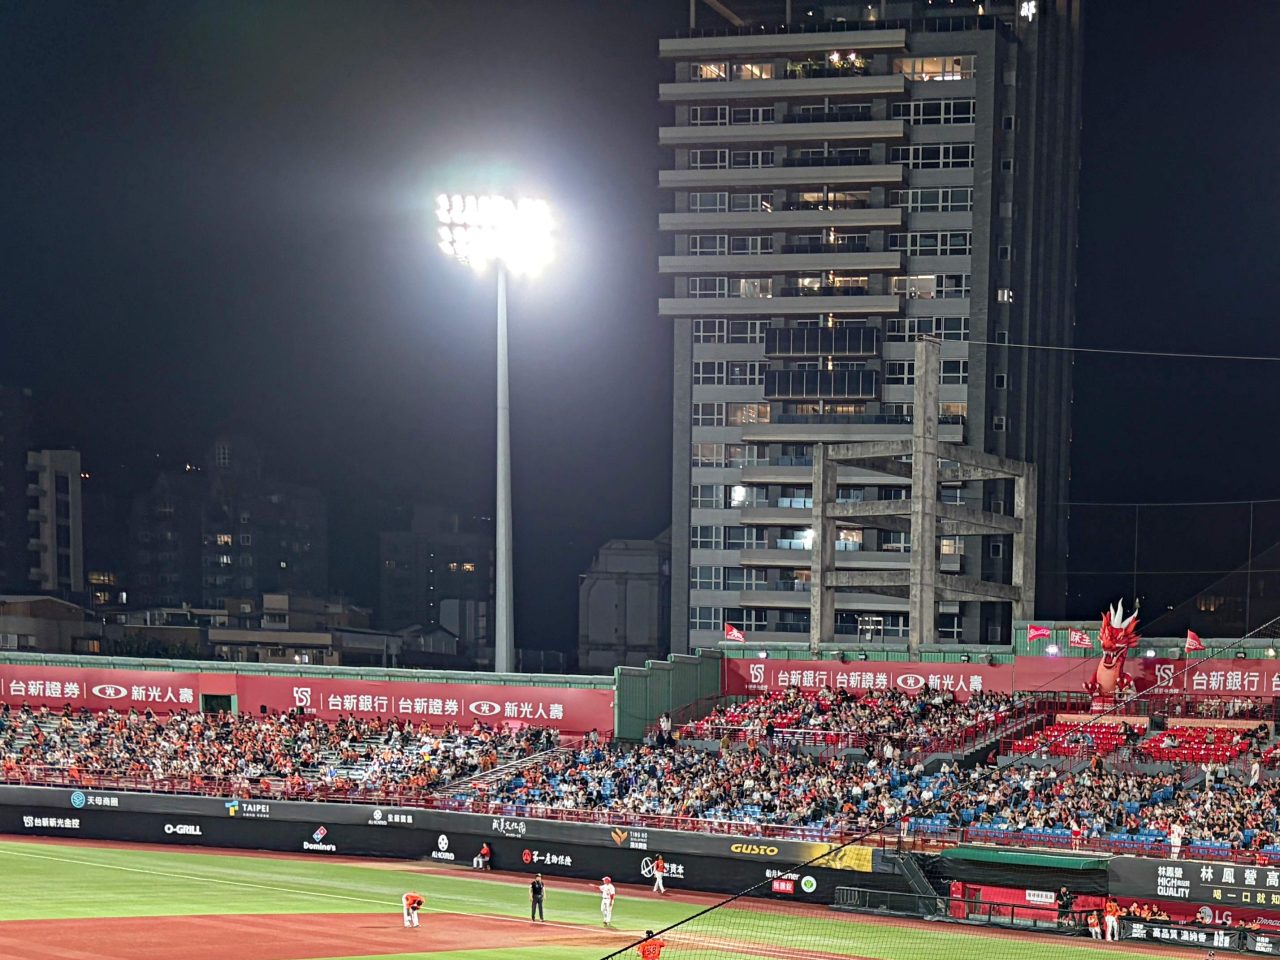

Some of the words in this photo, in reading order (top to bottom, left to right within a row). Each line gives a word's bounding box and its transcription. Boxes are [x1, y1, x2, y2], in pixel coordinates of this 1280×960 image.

[778, 670, 827, 688] 台新銀行
[836, 671, 888, 689] 台新證券
[928, 674, 983, 692] 新光人壽
[1192, 672, 1259, 692] 台新銀行
[9, 680, 81, 699] 台新證券
[131, 685, 194, 703] 新光人壽
[327, 694, 388, 712] 台新銀行
[398, 697, 459, 716] 台新證券
[504, 702, 564, 719] 新光人壽
[242, 803, 269, 813] TAIPEI
[164, 824, 202, 835] O-GRILL
[303, 841, 336, 851] Domino's
[730, 843, 779, 856] GUSTO
[1157, 877, 1177, 887] HIGH
[1157, 886, 1190, 898] QUALITY
[1216, 910, 1233, 926] LG
